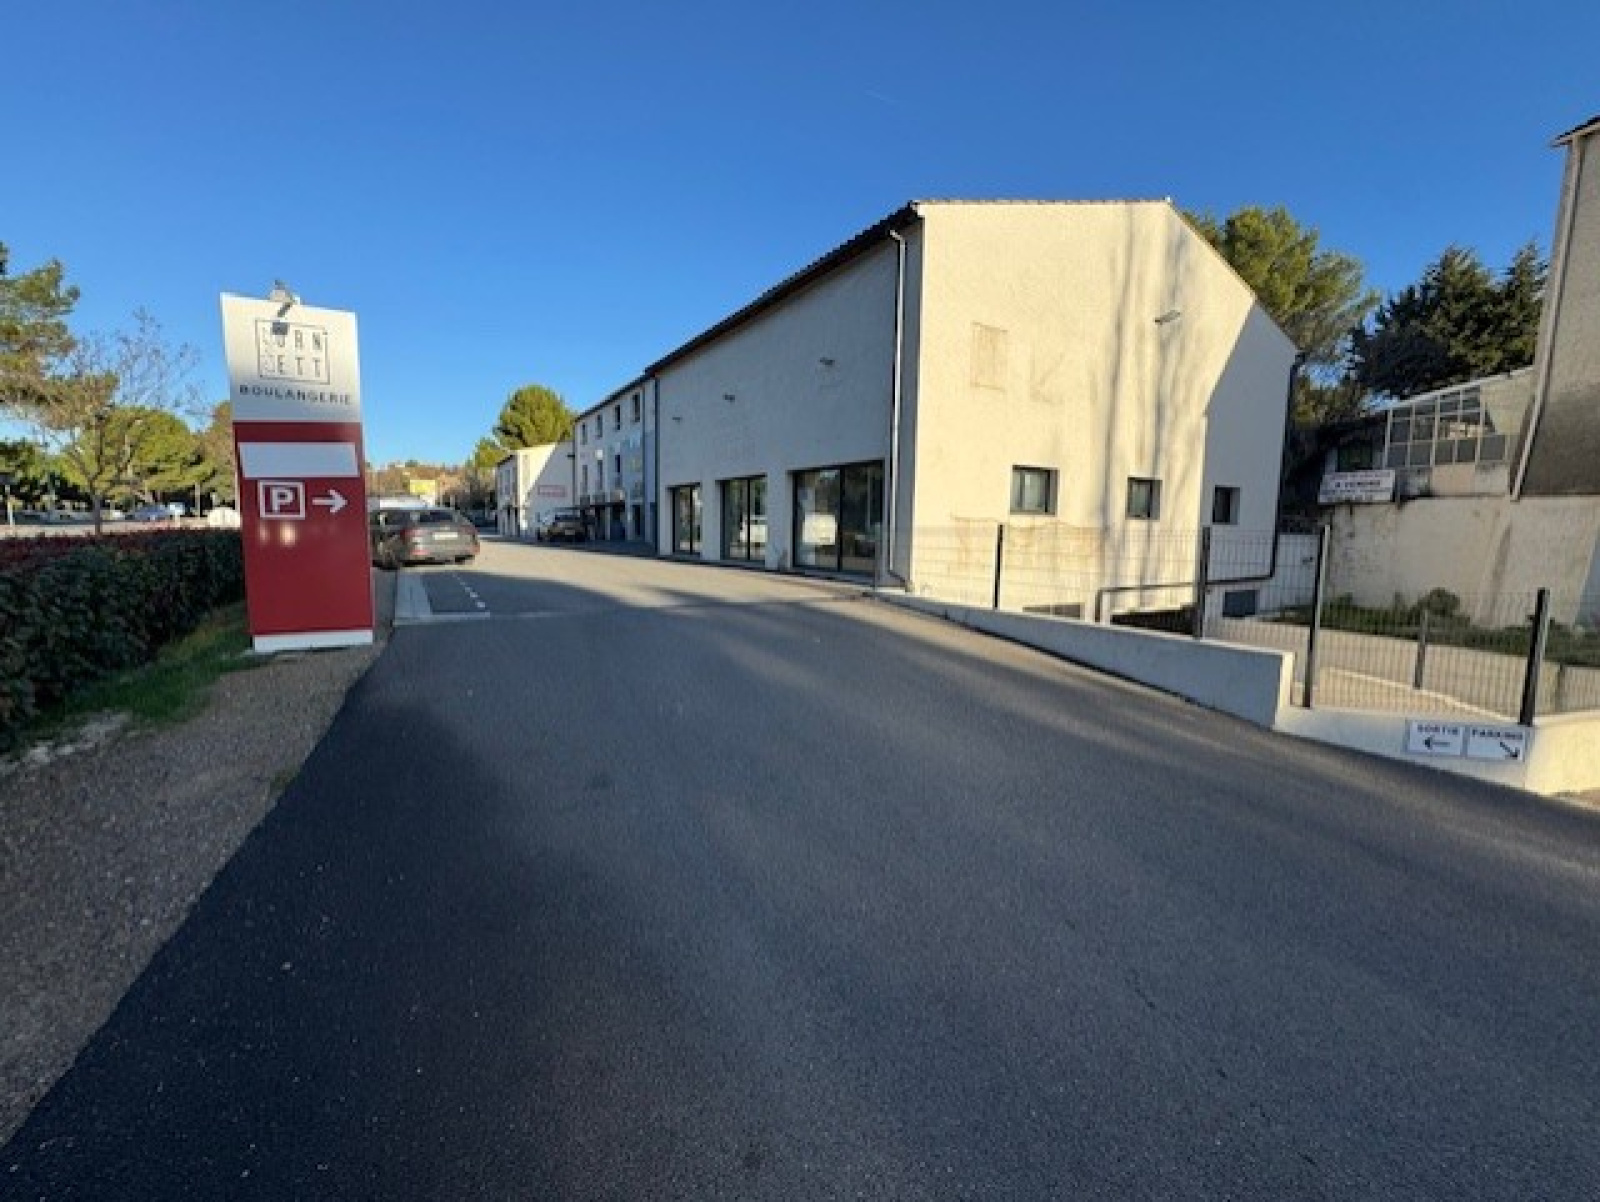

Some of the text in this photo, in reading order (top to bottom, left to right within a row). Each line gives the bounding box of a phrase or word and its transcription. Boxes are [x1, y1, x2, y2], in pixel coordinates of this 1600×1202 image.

[239, 384, 351, 405] BOULANGERIE
[271, 486, 295, 512] P
[1416, 724, 1459, 736] SORTIE
[1471, 729, 1524, 740] PARKING
